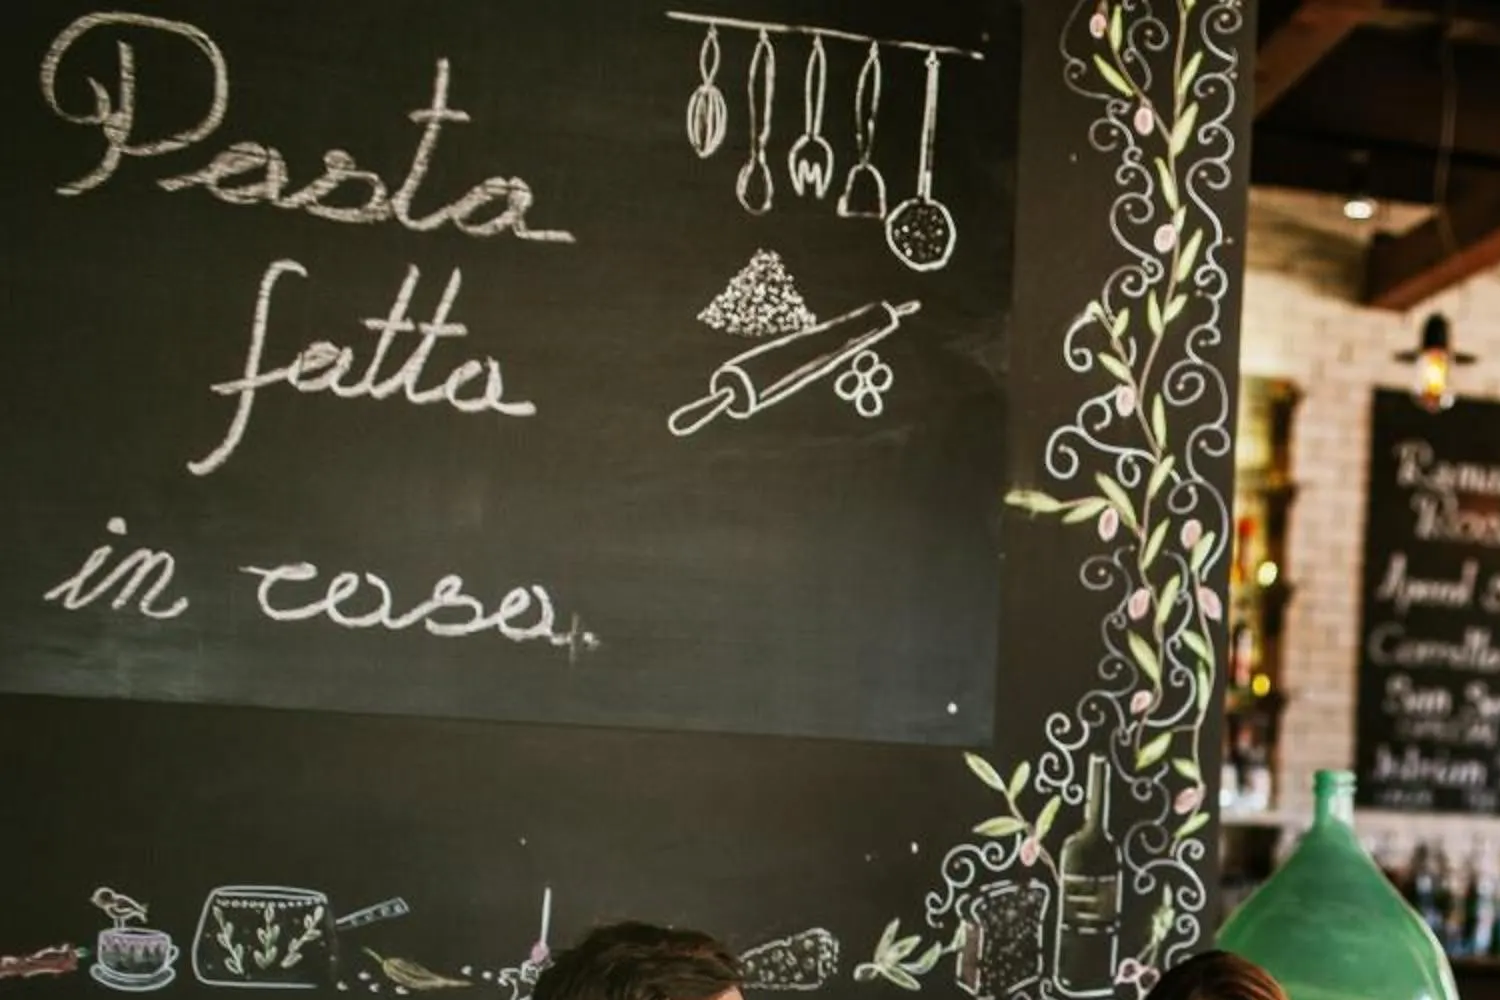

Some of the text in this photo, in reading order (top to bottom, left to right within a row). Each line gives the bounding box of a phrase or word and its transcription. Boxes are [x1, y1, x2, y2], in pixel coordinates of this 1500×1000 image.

[40, 11, 576, 244] Pasta
[187, 258, 536, 476] fatta
[44, 515, 189, 619] in
